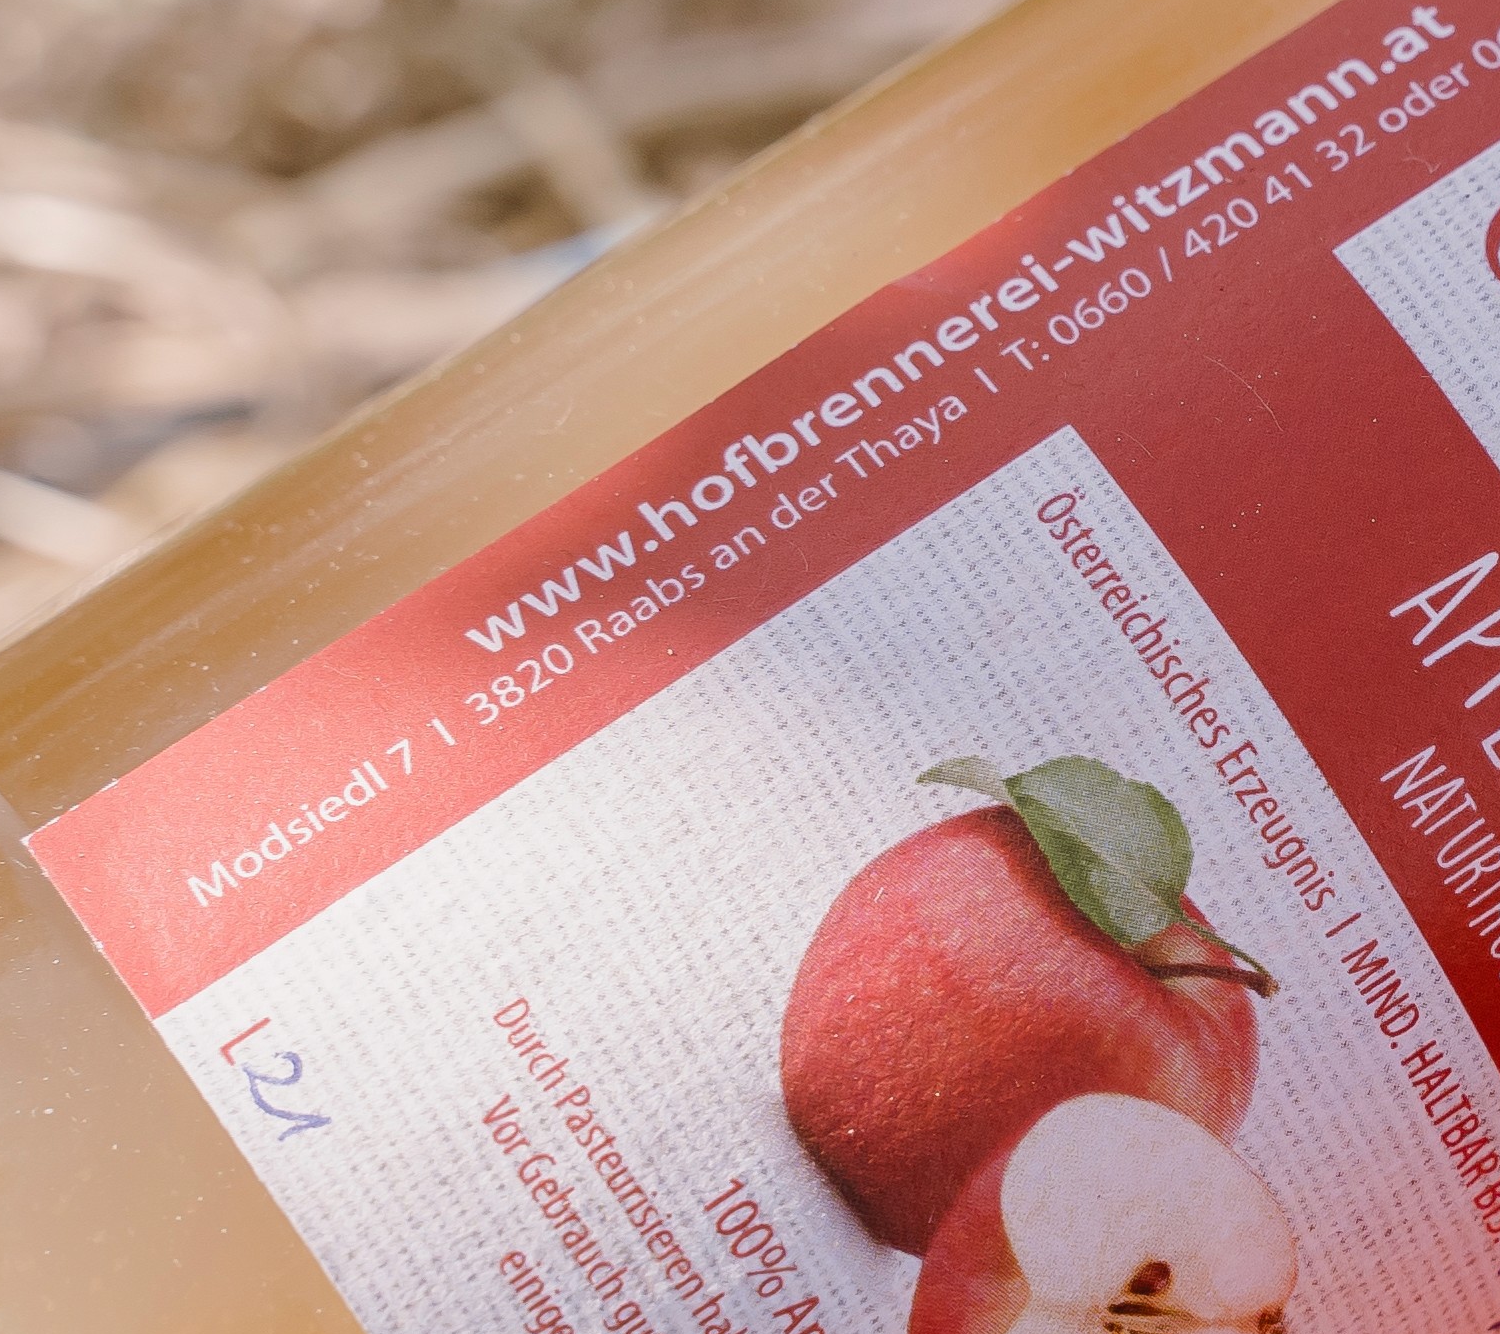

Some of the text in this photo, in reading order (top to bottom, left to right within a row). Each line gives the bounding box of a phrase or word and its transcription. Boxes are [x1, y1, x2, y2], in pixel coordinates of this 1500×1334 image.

[187, 762, 389, 907] Modsiedl
[386, 739, 415, 774] 7
[464, 642, 574, 726] 3820
[574, 563, 705, 654] Raabs
[712, 524, 767, 571] an
[770, 470, 841, 530] der
[837, 391, 968, 481] Thaya
[1001, 338, 1050, 371] T:
[1048, 268, 1152, 346] 0660
[1184, 197, 1260, 258] 420
[1265, 163, 1314, 207] 41
[1315, 123, 1376, 172] 32
[1378, 62, 1472, 134] oder
[465, 4, 1455, 654] www.hofbrennerei-witzmann.at
[1036, 486, 1230, 749] Österreichisches
[1216, 740, 1337, 912] Erzeugnis
[1341, 939, 1420, 1050] MIND.
[482, 1095, 530, 1161] Vor
[517, 1151, 624, 1313] Gebrauch
[492, 998, 568, 1095] Durch
[558, 1084, 707, 1304] Pasteurisieren
[703, 1177, 798, 1299] 100%
